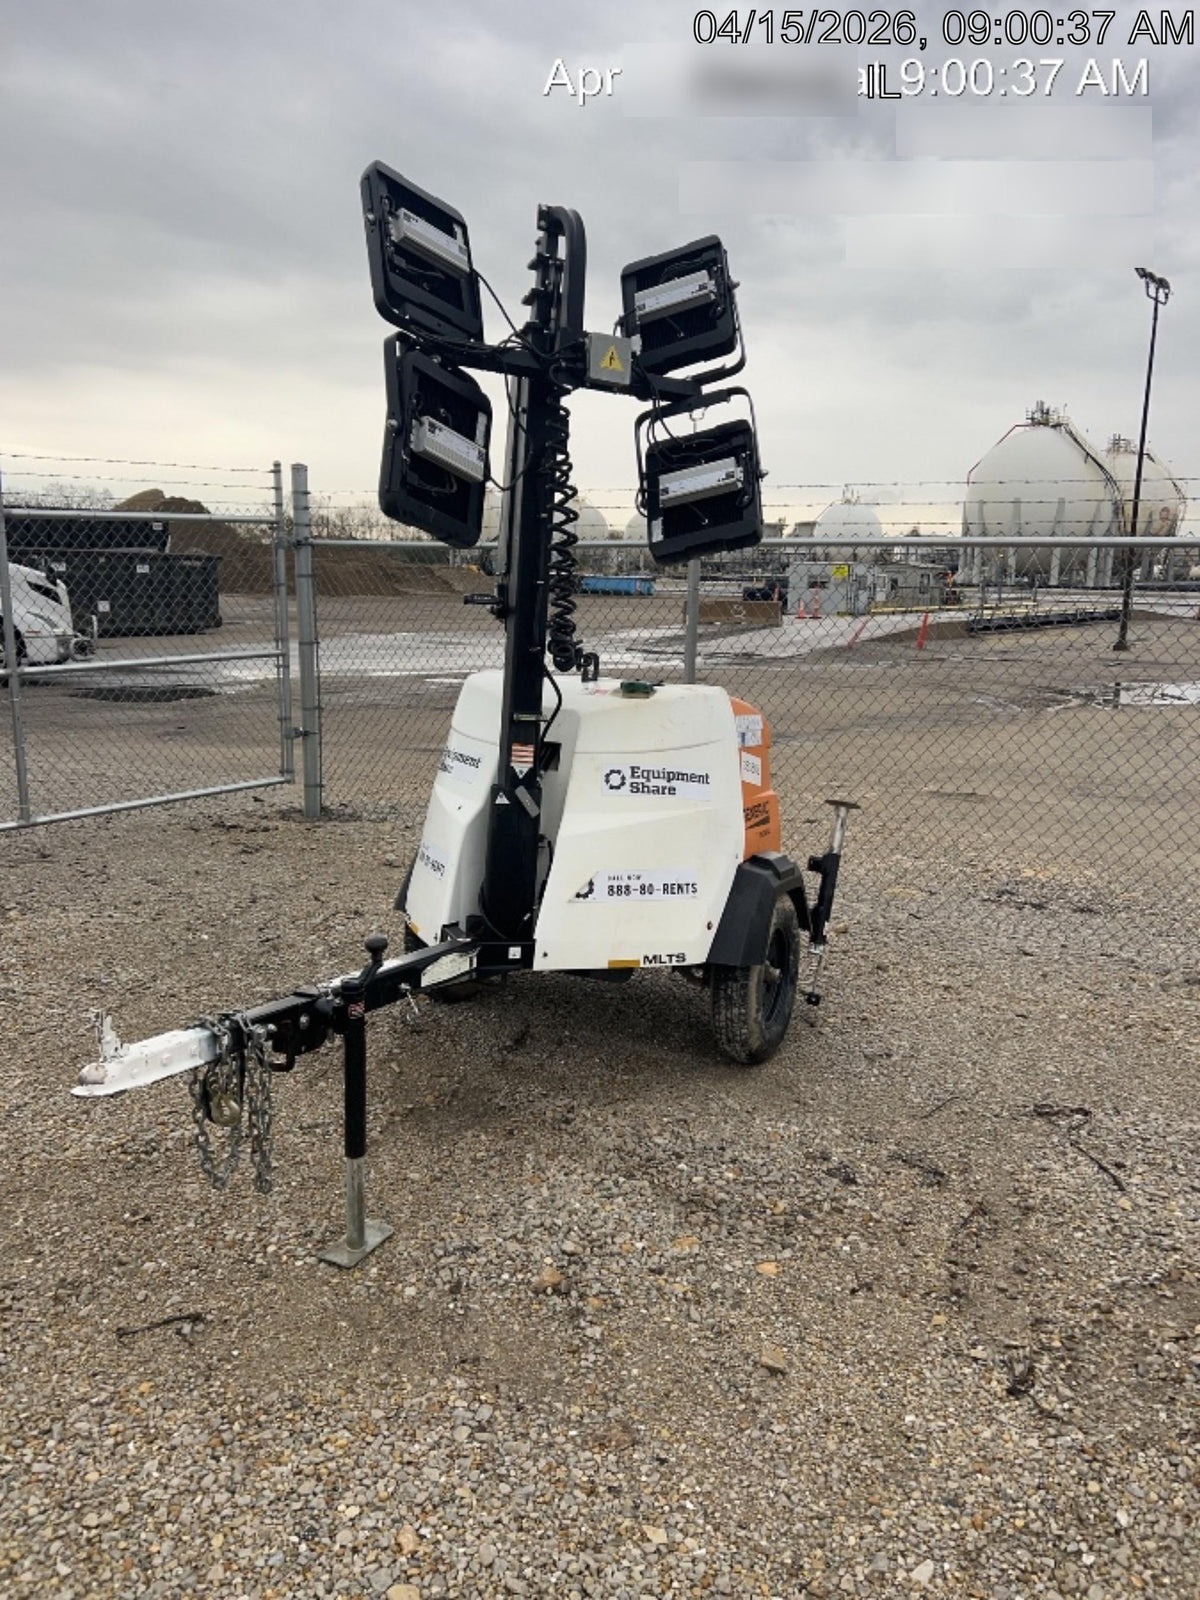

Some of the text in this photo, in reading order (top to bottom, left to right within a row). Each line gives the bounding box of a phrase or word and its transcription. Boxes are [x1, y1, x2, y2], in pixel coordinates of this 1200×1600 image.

[629, 766, 710, 785] Equipment
[629, 781, 677, 796] Share
[607, 882, 698, 897] 888-80-RENTS
[642, 953, 687, 965] MLTS
